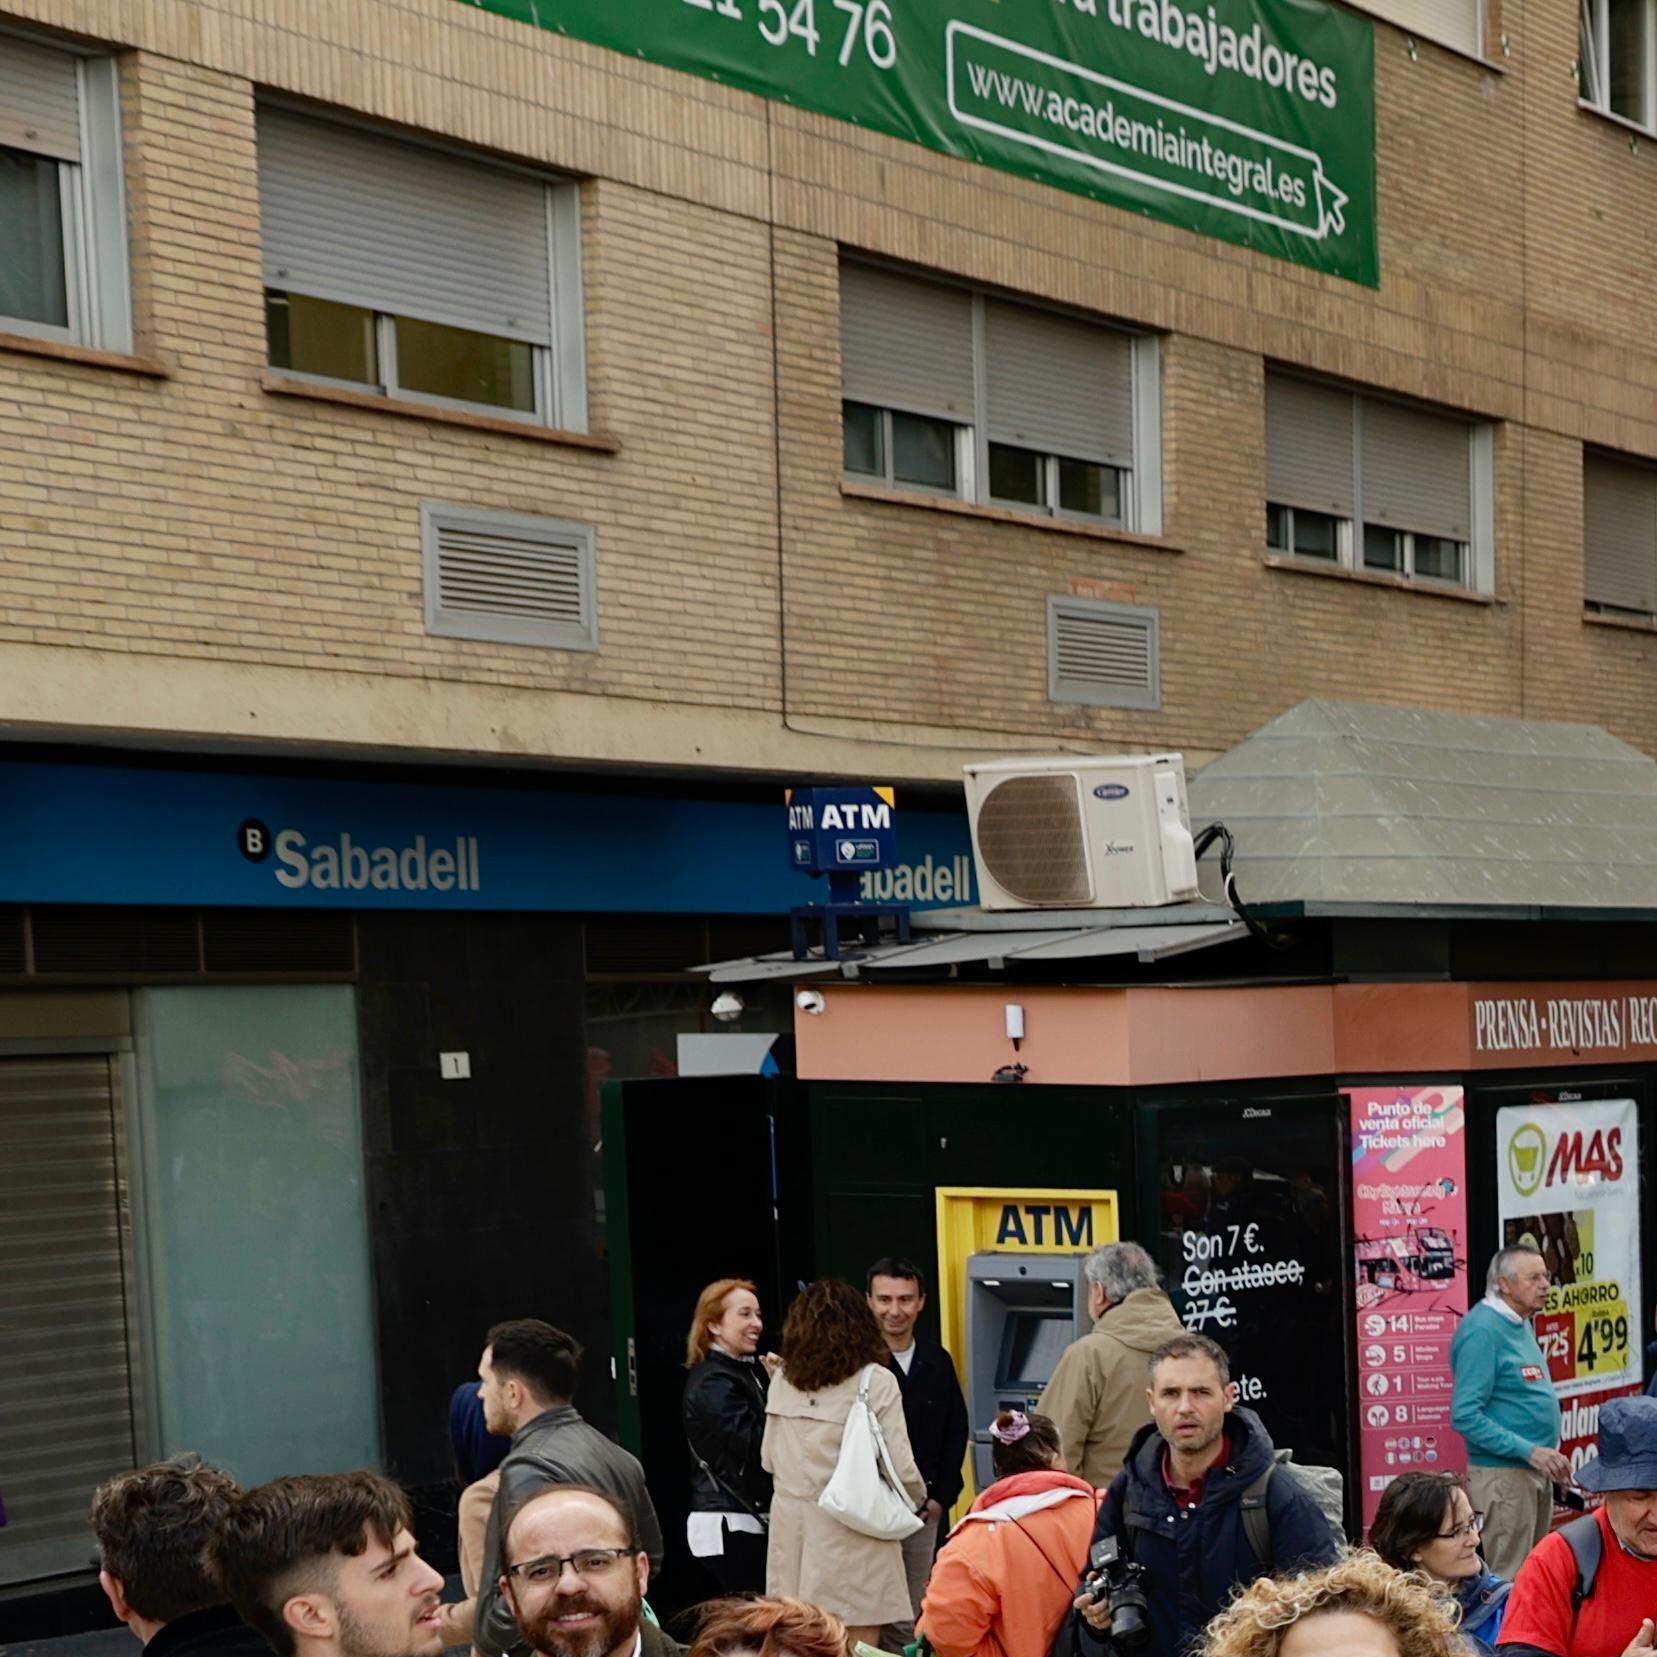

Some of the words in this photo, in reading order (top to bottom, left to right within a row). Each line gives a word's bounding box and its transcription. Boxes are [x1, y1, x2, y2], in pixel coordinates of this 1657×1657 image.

[1106, 0, 1338, 109] trabajadores
[966, 60, 1306, 208] www.academiaintegral.es
[789, 804, 814, 831] ATM
[821, 803, 891, 830] ATM
[274, 829, 480, 891] Sabadell
[859, 854, 970, 902] abadell
[1474, 999, 1541, 1050] PRENSA
[1547, 998, 1620, 1048] REVISTAS
[1358, 1118, 1400, 1132] venta
[1402, 1115, 1445, 1131] oficial
[1367, 1102, 1411, 1118] Punto
[1413, 1102, 1432, 1115] de
[1358, 1133, 1410, 1150] Tickets
[1412, 1133, 1446, 1148] here
[1545, 1127, 1624, 1188] MAS
[996, 1204, 1092, 1246] ATM
[1182, 1231, 1223, 1263] Son
[1226, 1225, 1240, 1256] 7
[1182, 1265, 1228, 1298] Con
[1231, 1258, 1305, 1293] atasco,
[1562, 1283, 1619, 1308] AHORRO
[1387, 1315, 1409, 1333] 14
[1393, 1345, 1406, 1363] 5
[1231, 1374, 1267, 1403] ete.
[1393, 1375, 1402, 1393] 1
[1395, 1405, 1408, 1423] 8
